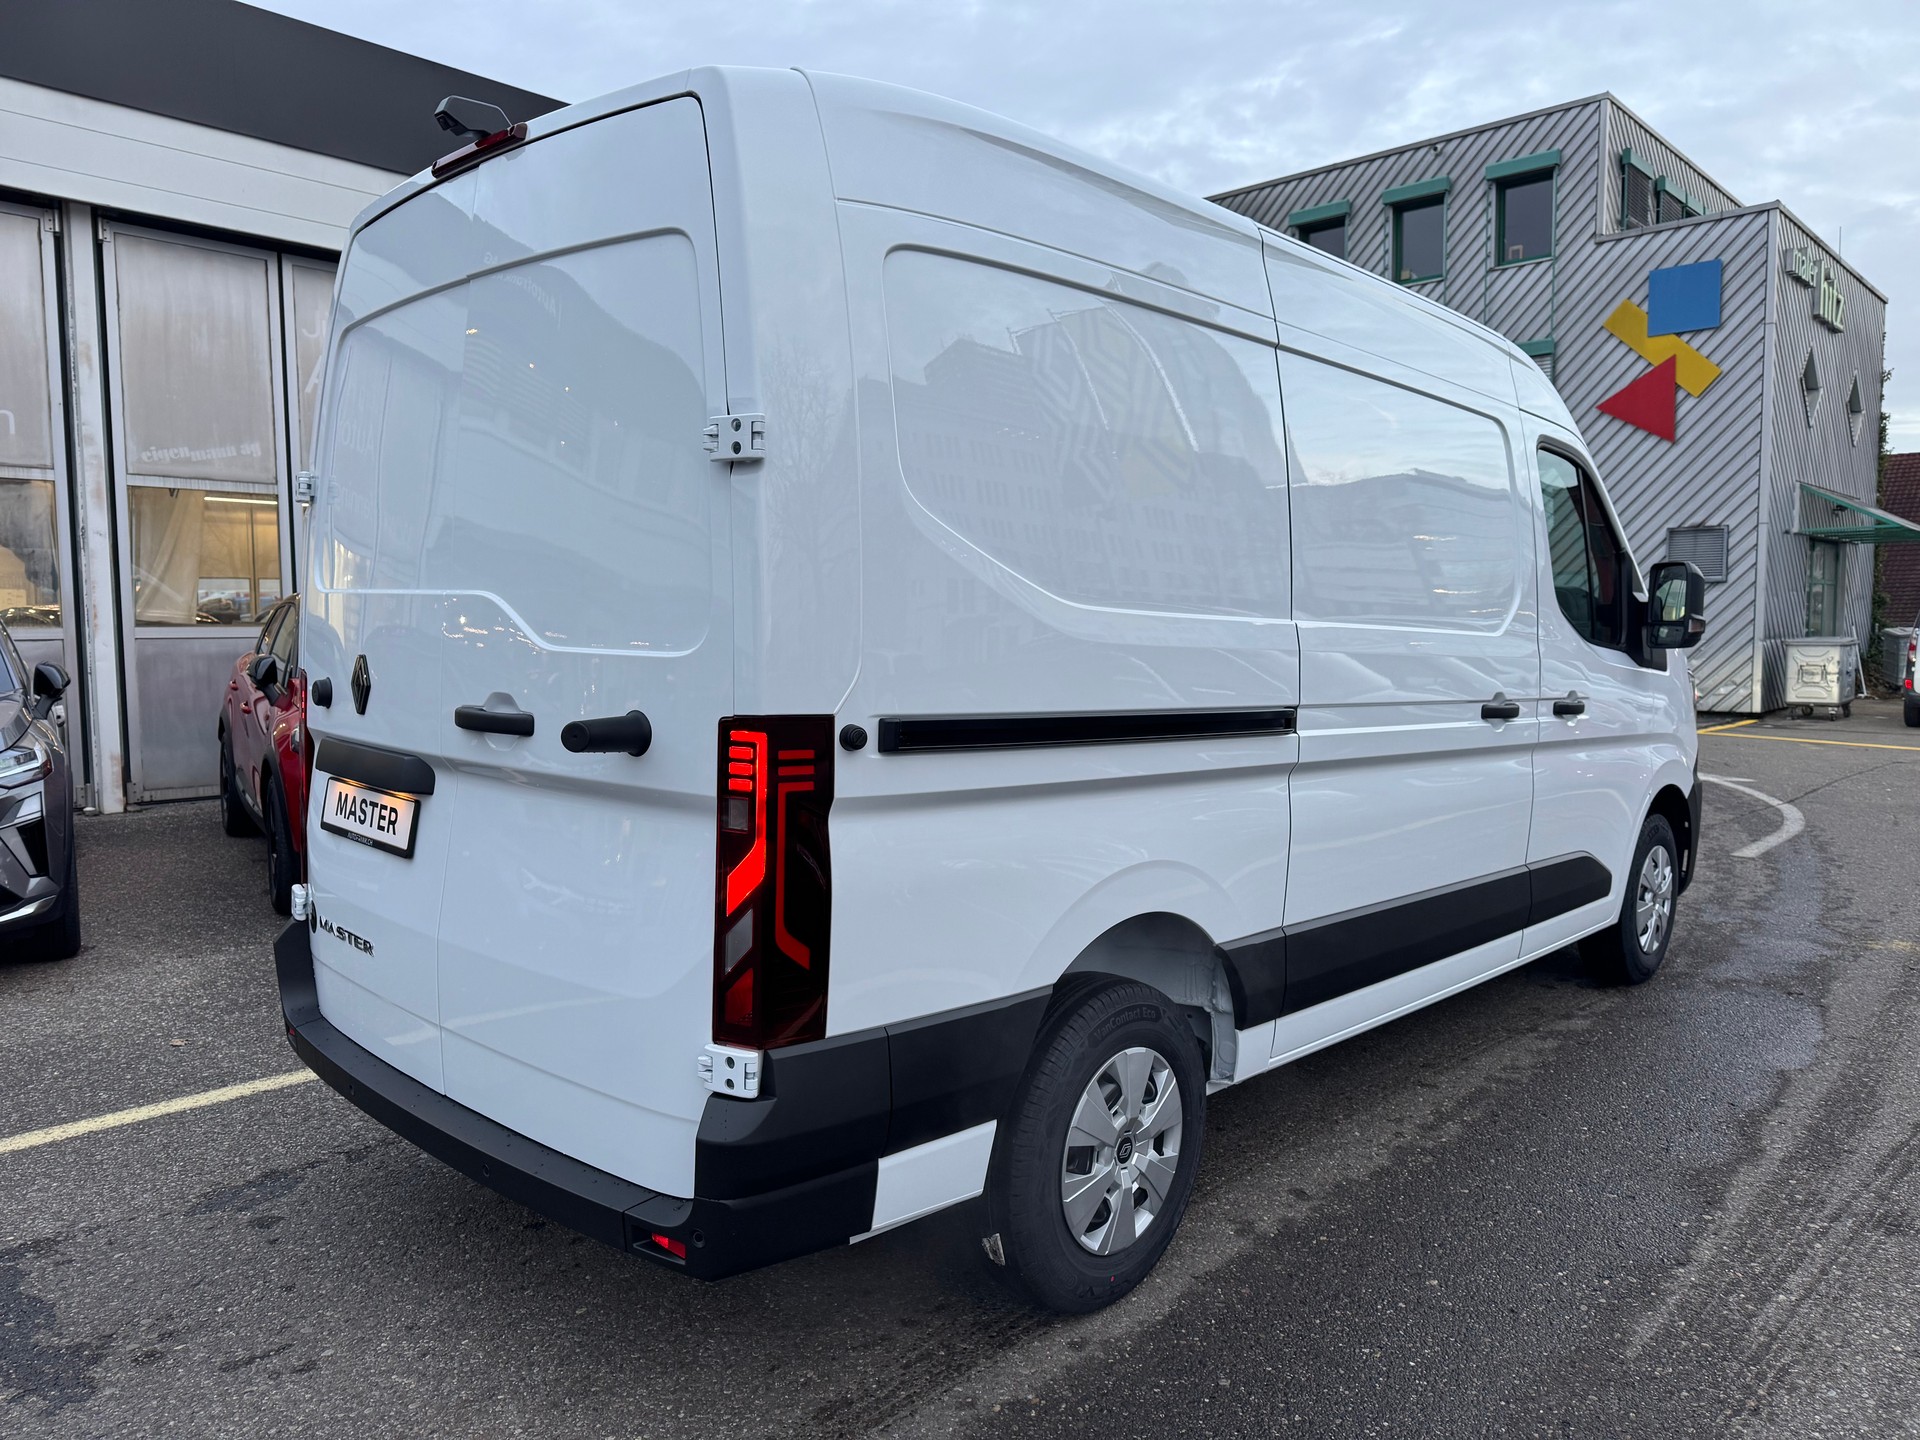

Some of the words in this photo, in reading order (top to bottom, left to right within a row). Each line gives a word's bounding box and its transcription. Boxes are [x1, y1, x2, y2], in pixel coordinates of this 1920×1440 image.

[1817, 260, 1844, 333] hitz
[335, 791, 399, 836] MASTER
[319, 915, 375, 957] MASTER
[1094, 1007, 1140, 1040] VanContact
[1142, 1007, 1156, 1019] Eco
